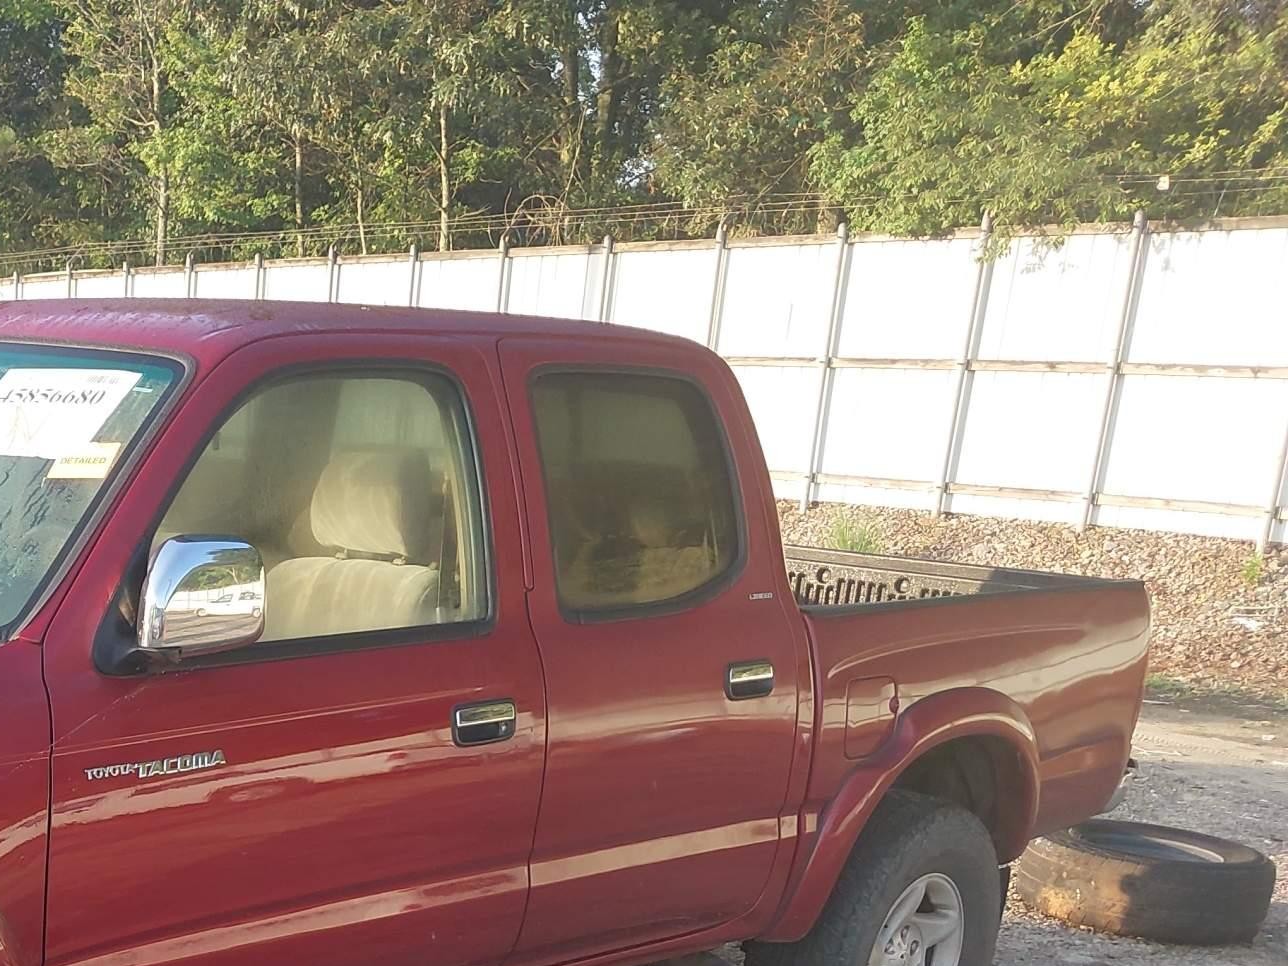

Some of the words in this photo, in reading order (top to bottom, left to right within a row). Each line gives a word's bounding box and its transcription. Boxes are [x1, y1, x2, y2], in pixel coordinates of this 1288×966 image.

[0, 387, 107, 405] 45856680
[59, 456, 107, 465] DETAILED
[84, 763, 135, 780] TOYOTA
[135, 750, 227, 779] TACOMA
